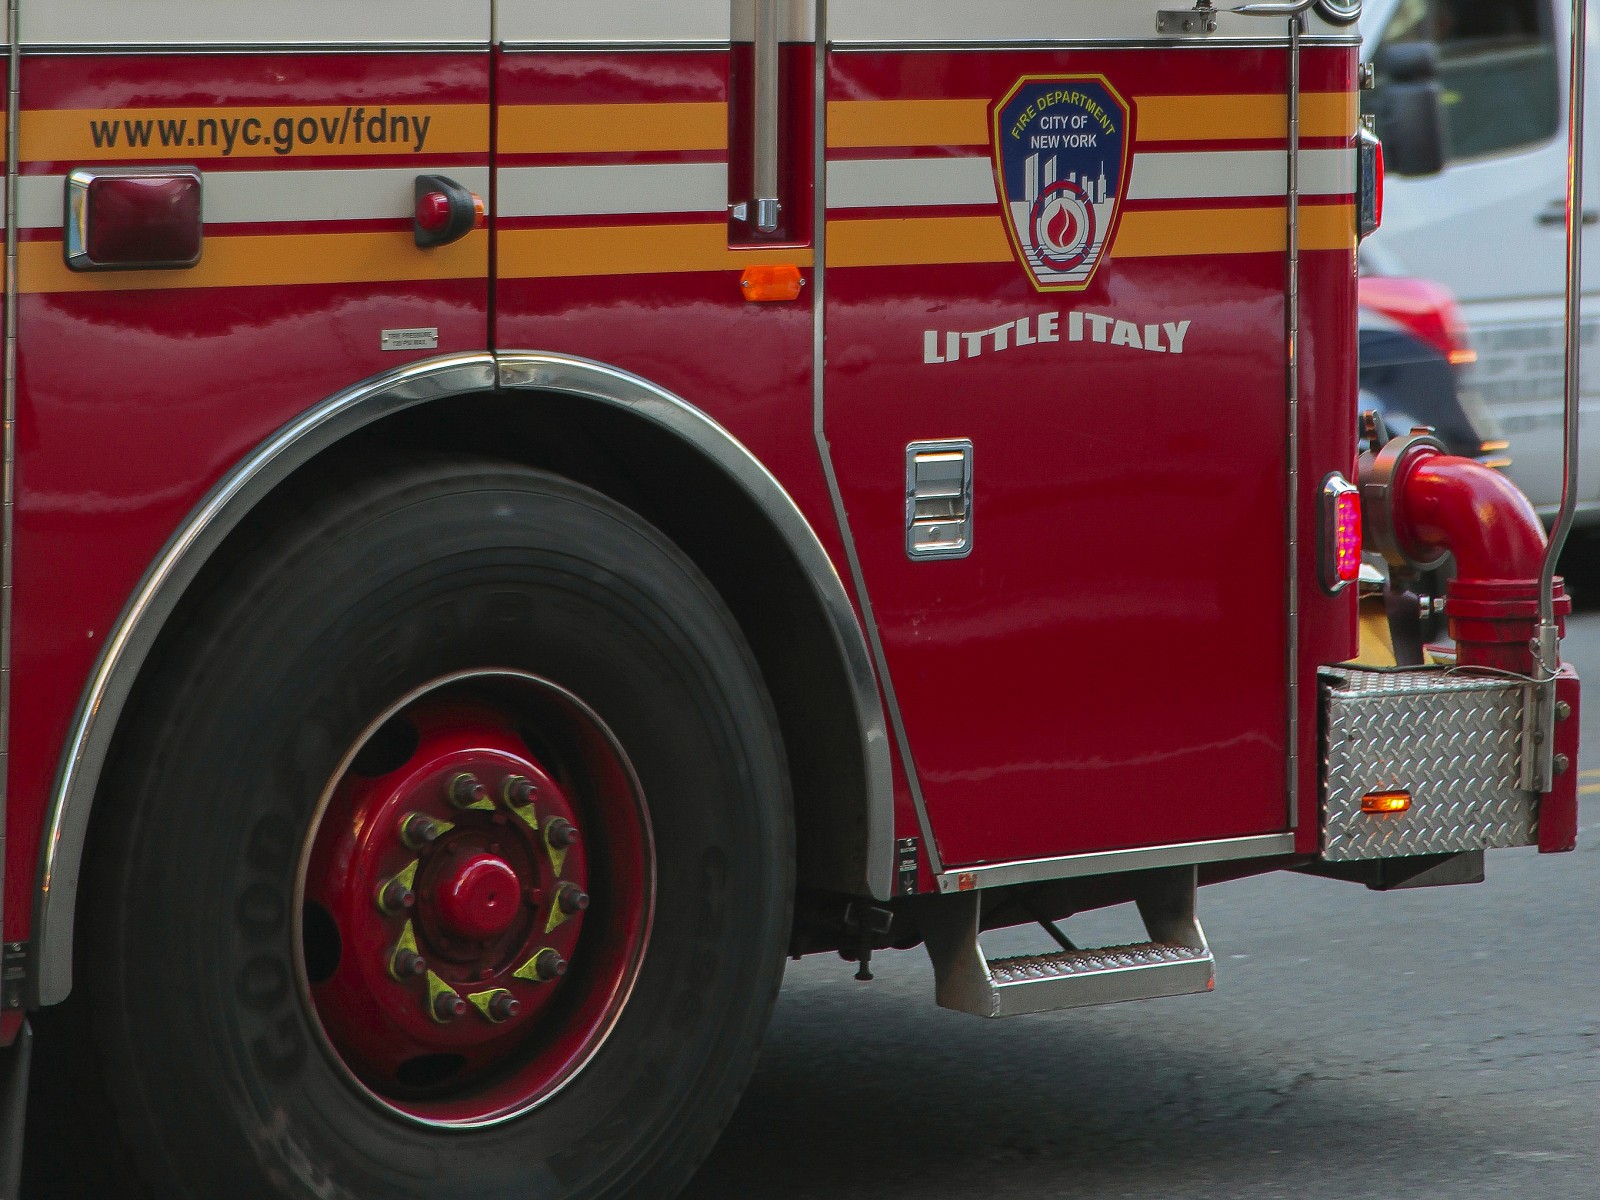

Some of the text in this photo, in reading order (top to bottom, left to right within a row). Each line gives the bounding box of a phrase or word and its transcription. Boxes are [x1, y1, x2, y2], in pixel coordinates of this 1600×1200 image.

[89, 107, 432, 156] www.nyc.gov/fdny
[1011, 90, 1116, 140] FIRE DEPARTMENT
[1040, 115, 1088, 130] CITY OF
[1031, 134, 1097, 149] NEW YORK
[923, 311, 1192, 364] LITTLE ITALY
